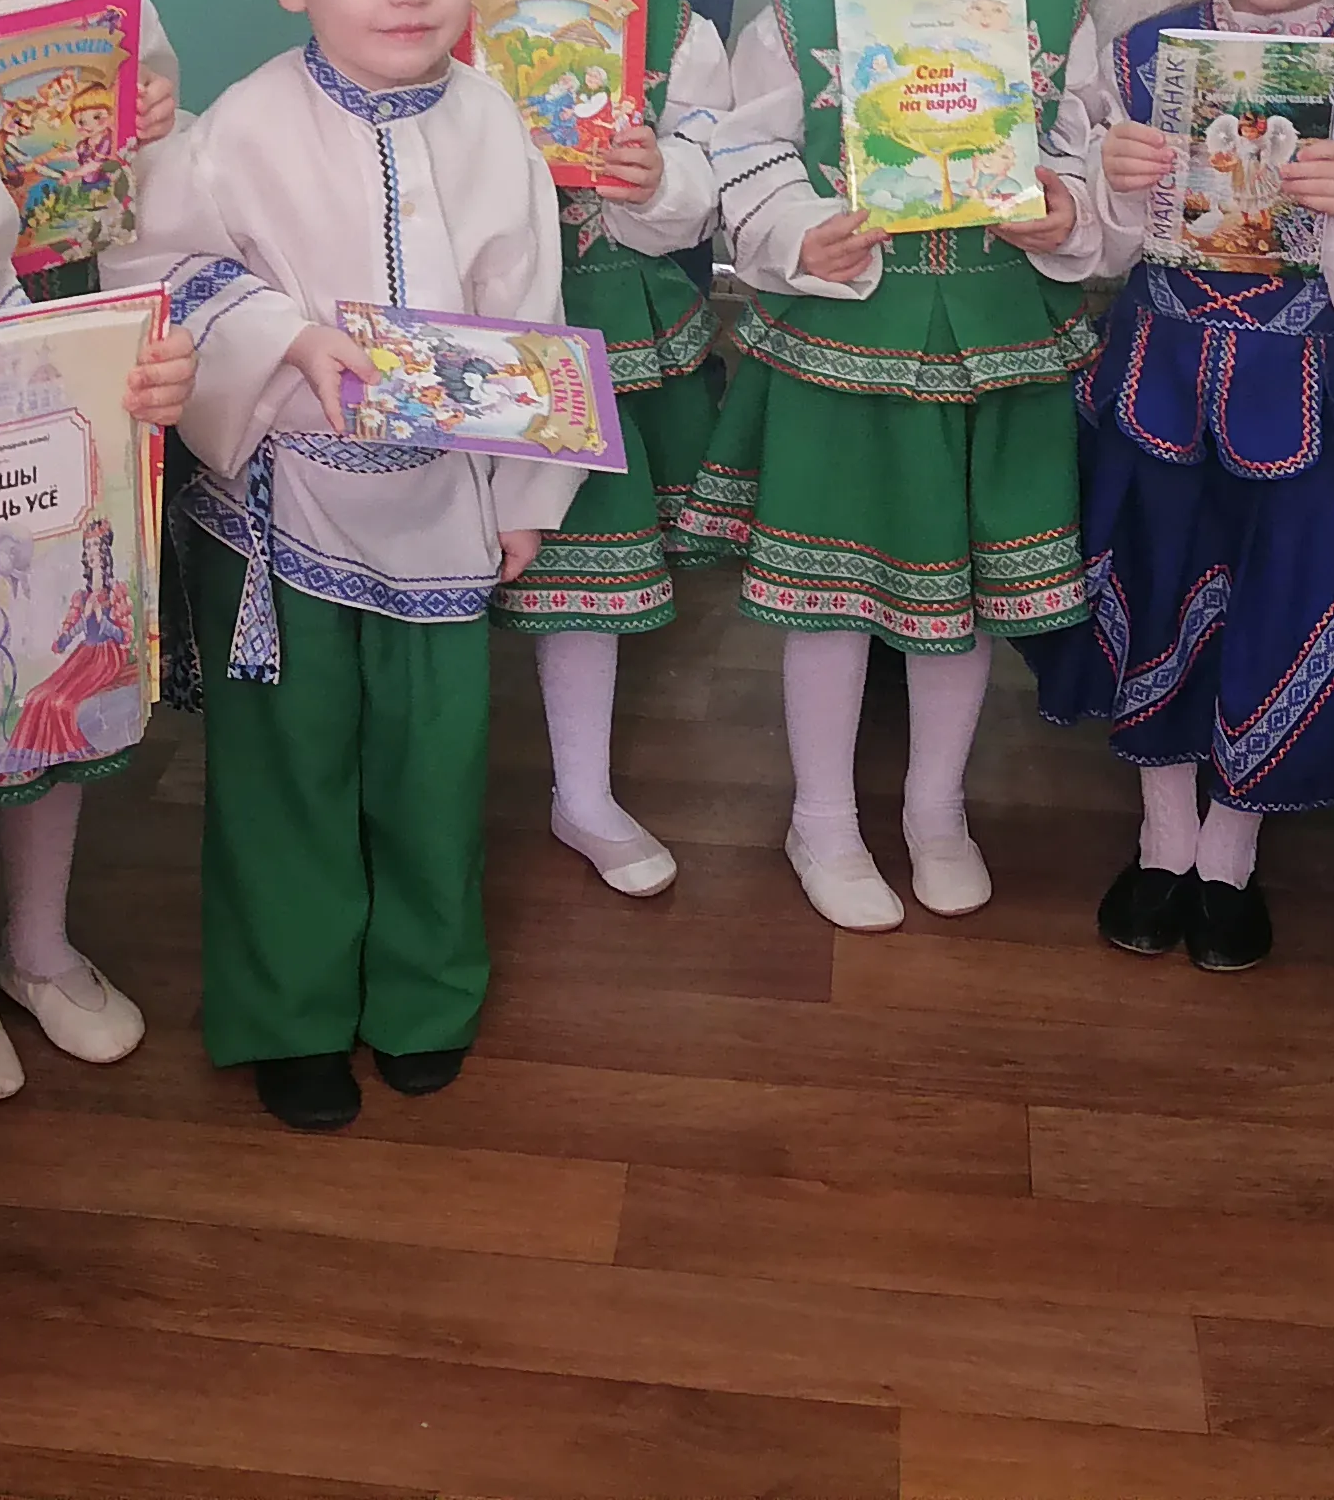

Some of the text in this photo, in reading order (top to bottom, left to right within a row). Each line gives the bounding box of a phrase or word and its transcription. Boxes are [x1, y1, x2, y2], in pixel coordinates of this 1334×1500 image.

[916, 63, 954, 80] Селі
[903, 77, 967, 97] хмаркі
[899, 95, 977, 114] на вярбу
[1152, 56, 1185, 241] МАЙС РАНАК
[548, 367, 568, 413] ХАТКА
[25, 484, 59, 513] УСЁ
